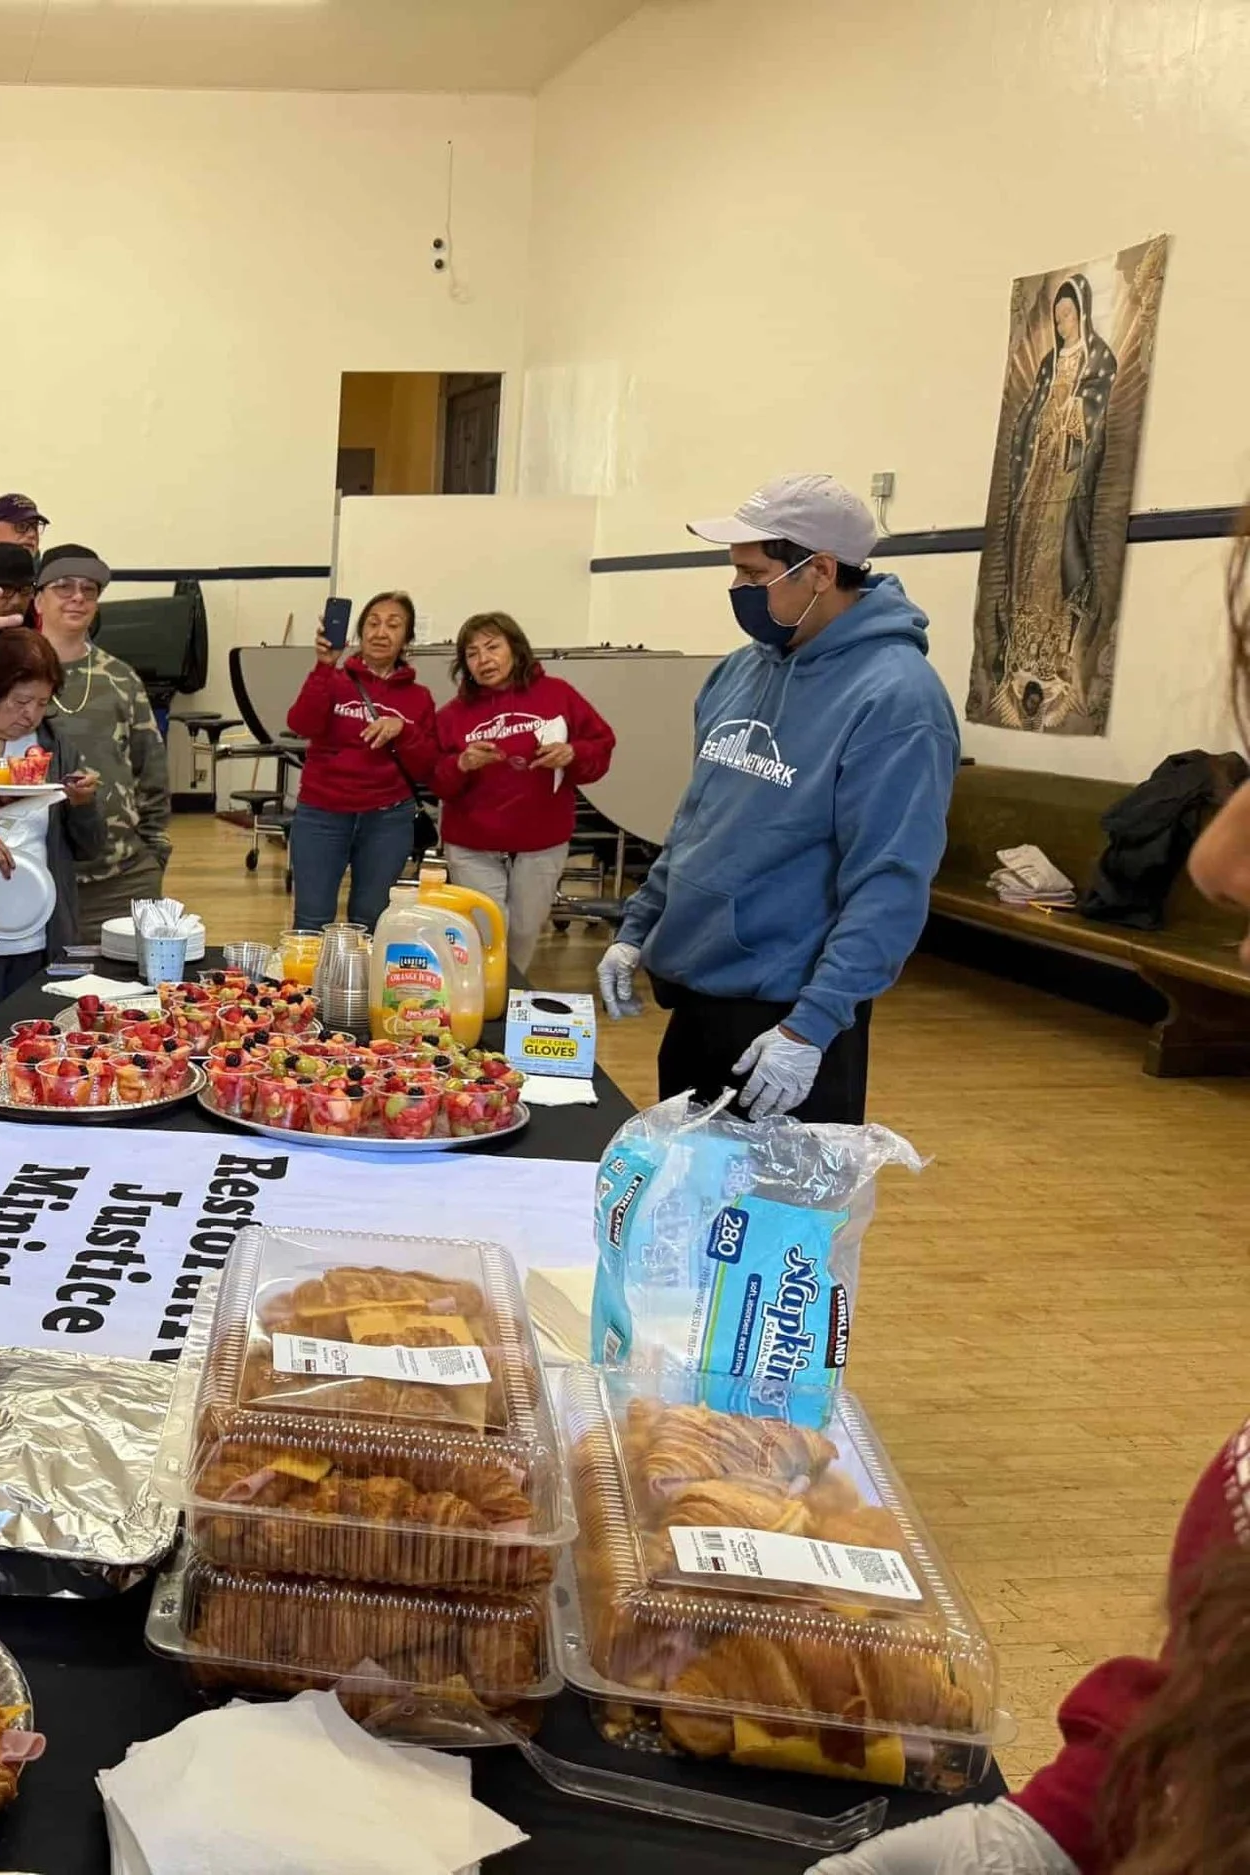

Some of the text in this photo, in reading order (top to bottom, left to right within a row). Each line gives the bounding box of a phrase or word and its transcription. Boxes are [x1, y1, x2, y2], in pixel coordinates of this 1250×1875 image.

[506, 719, 548, 736] NETWO
[742, 753, 797, 786] NETWORK
[524, 1045, 575, 1057] GLOVES
[612, 1177, 641, 1244] KIRKLAND
[717, 1216, 743, 1257] 280
[41, 1182, 183, 1334] Justice
[150, 1153, 290, 1362] Restora
[834, 1289, 847, 1366] KIRKLAND
